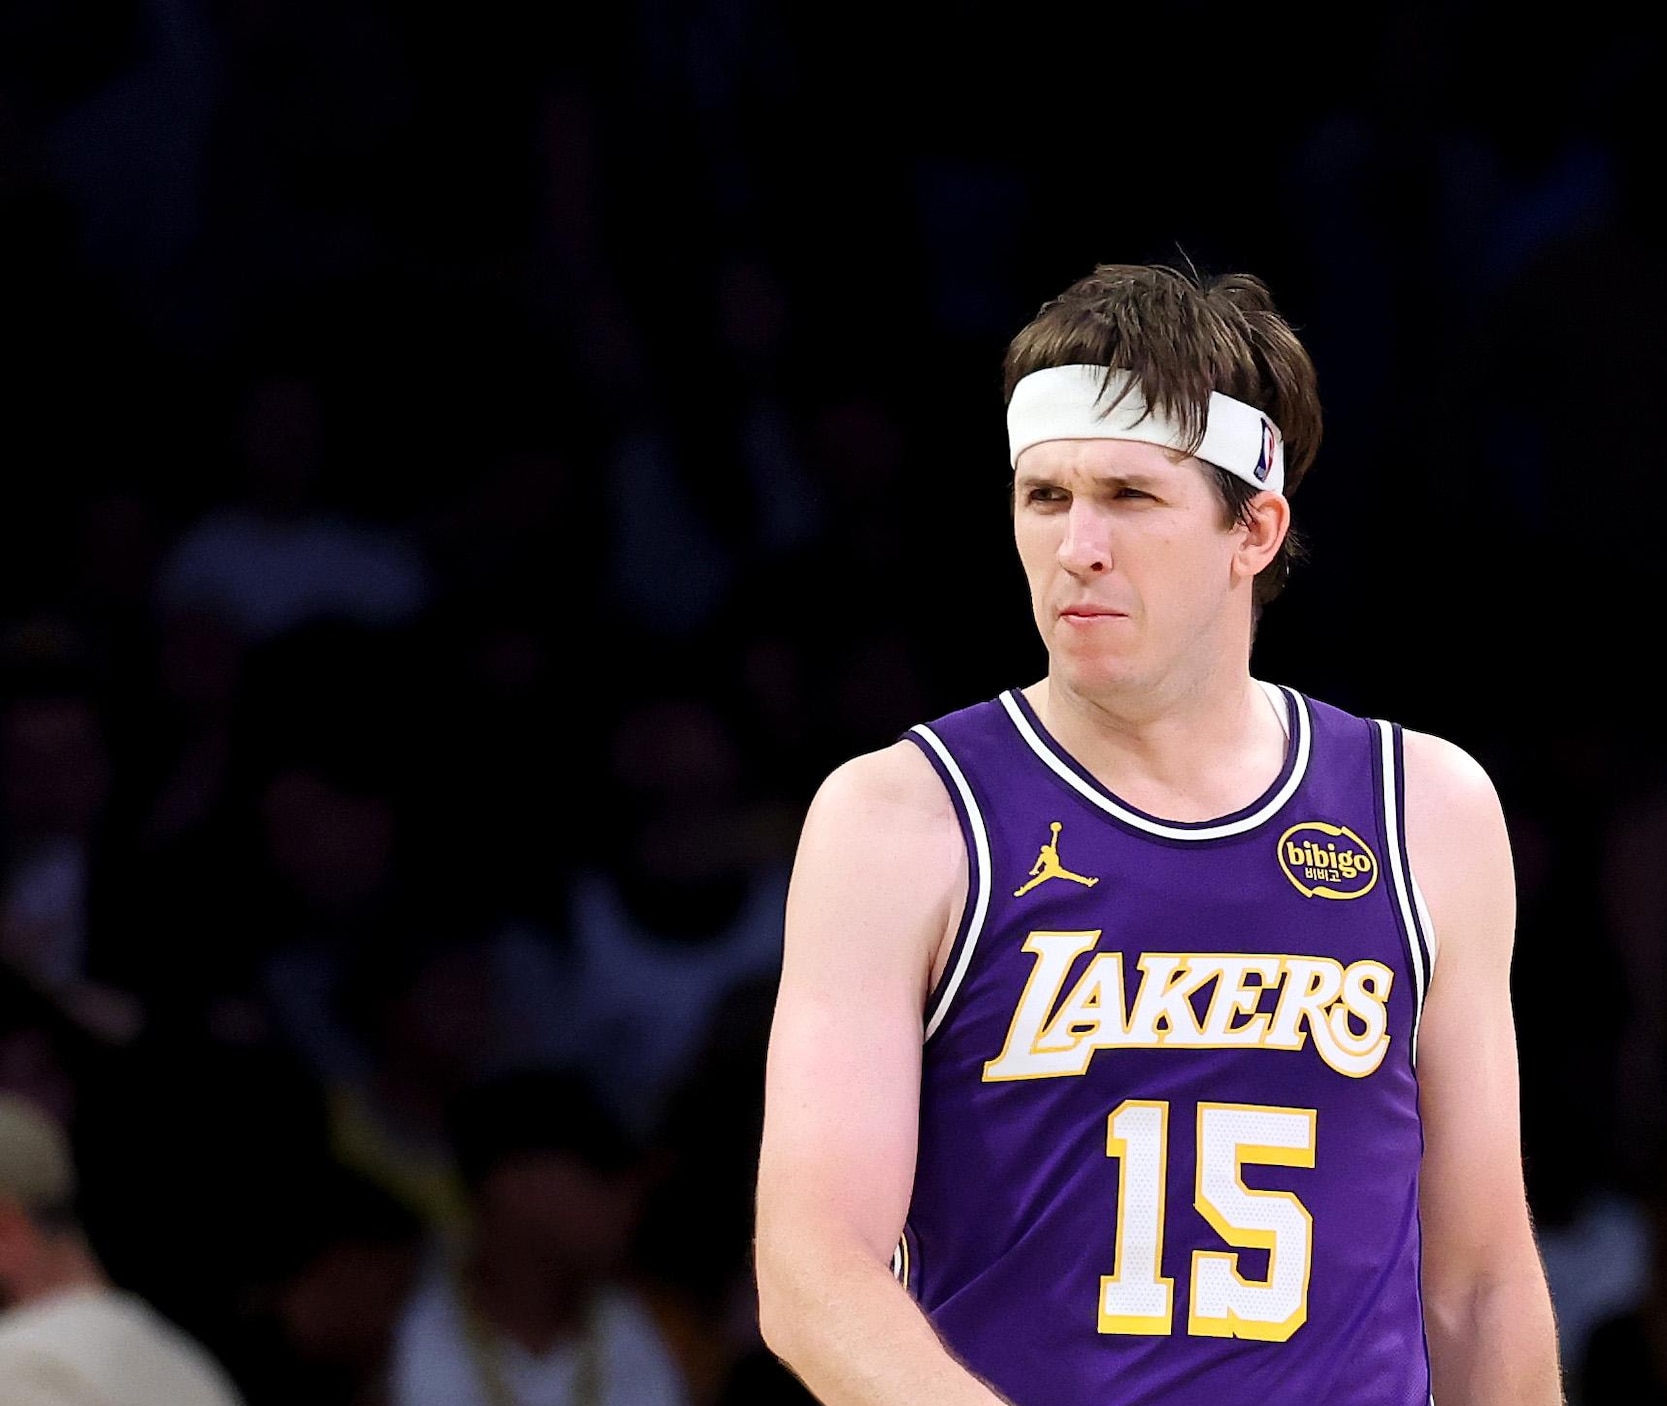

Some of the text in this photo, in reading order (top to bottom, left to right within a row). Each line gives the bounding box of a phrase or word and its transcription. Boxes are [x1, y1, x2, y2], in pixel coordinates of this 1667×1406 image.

[1286, 840, 1371, 879] bibigo
[1304, 867, 1342, 883] 비비고
[982, 930, 1395, 1082] LAKERS
[1097, 1100, 1317, 1342] 15
